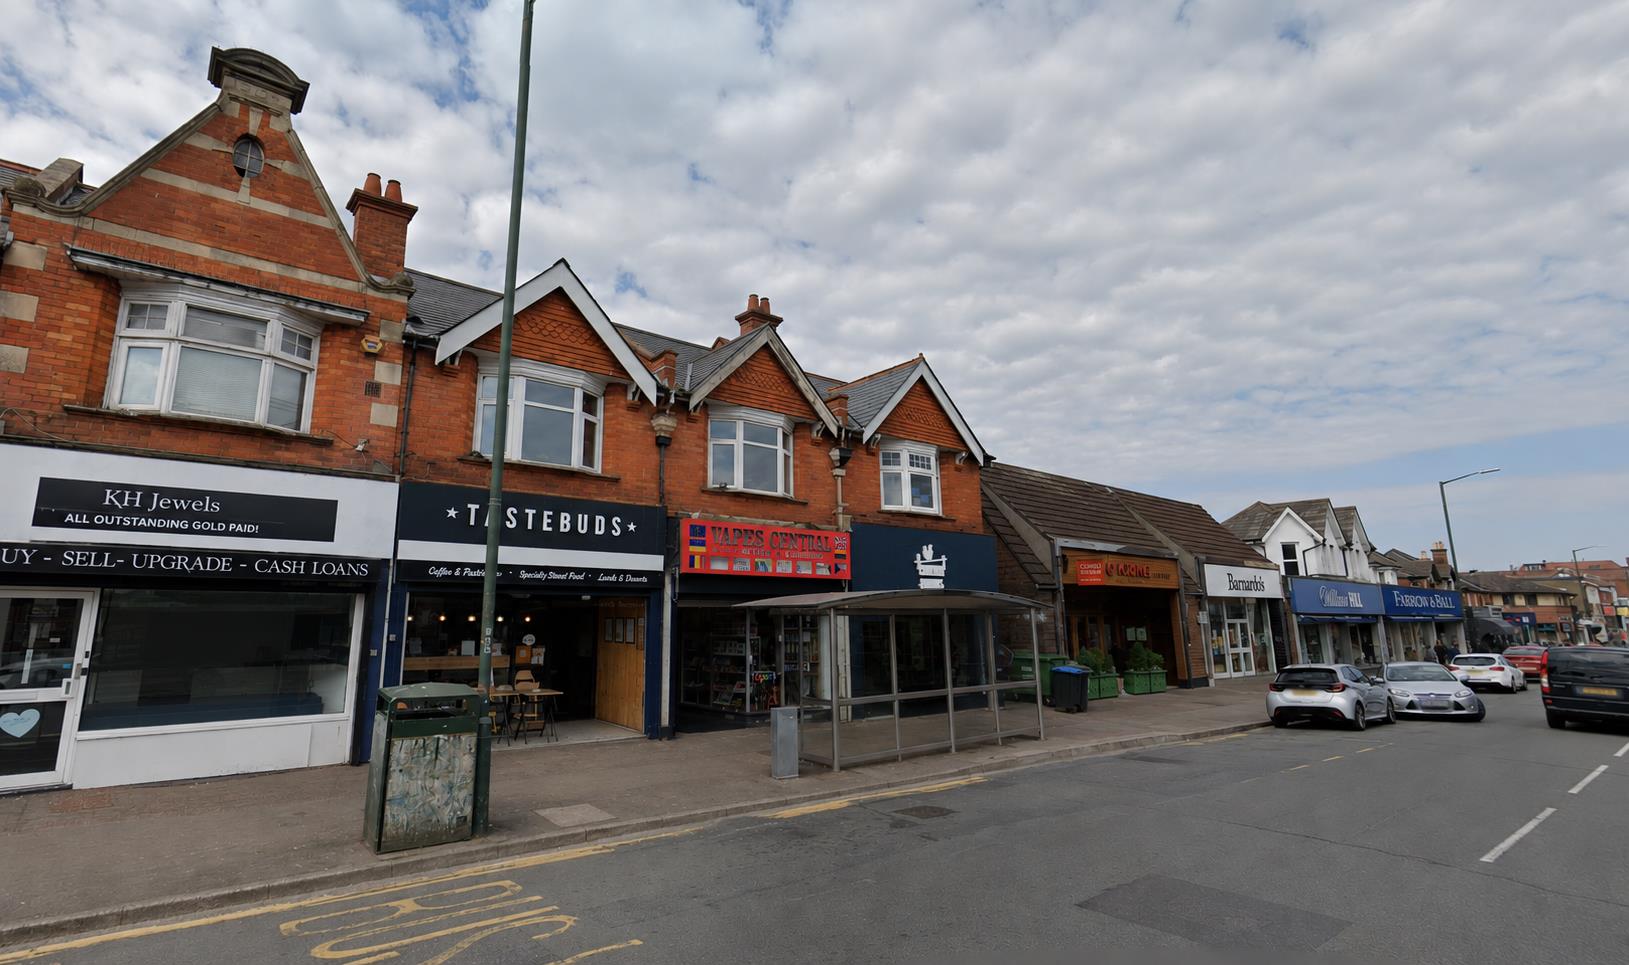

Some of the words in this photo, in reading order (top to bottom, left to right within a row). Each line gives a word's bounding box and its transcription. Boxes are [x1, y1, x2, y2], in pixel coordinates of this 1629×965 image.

[102, 488, 143, 509] KH
[148, 492, 220, 513] Jewels
[64, 513, 90, 524] ALL
[94, 514, 189, 530] OUTSTANDING
[192, 520, 226, 532] GOLD
[229, 523, 259, 534] PAID!
[711, 526, 765, 548] VAPES
[768, 530, 832, 553] CENTRAL
[131, 553, 233, 573] UPGRADE
[254, 558, 306, 574] CASH
[311, 561, 369, 577] LOANS
[428, 566, 453, 578] Coffee
[568, 572, 586, 580] Food
[1226, 572, 1266, 592] Barnardo's
[1319, 585, 1349, 607] William
[1347, 591, 1364, 608] HILL
[1392, 590, 1429, 607] FARROW
[1434, 594, 1456, 609] BALL
